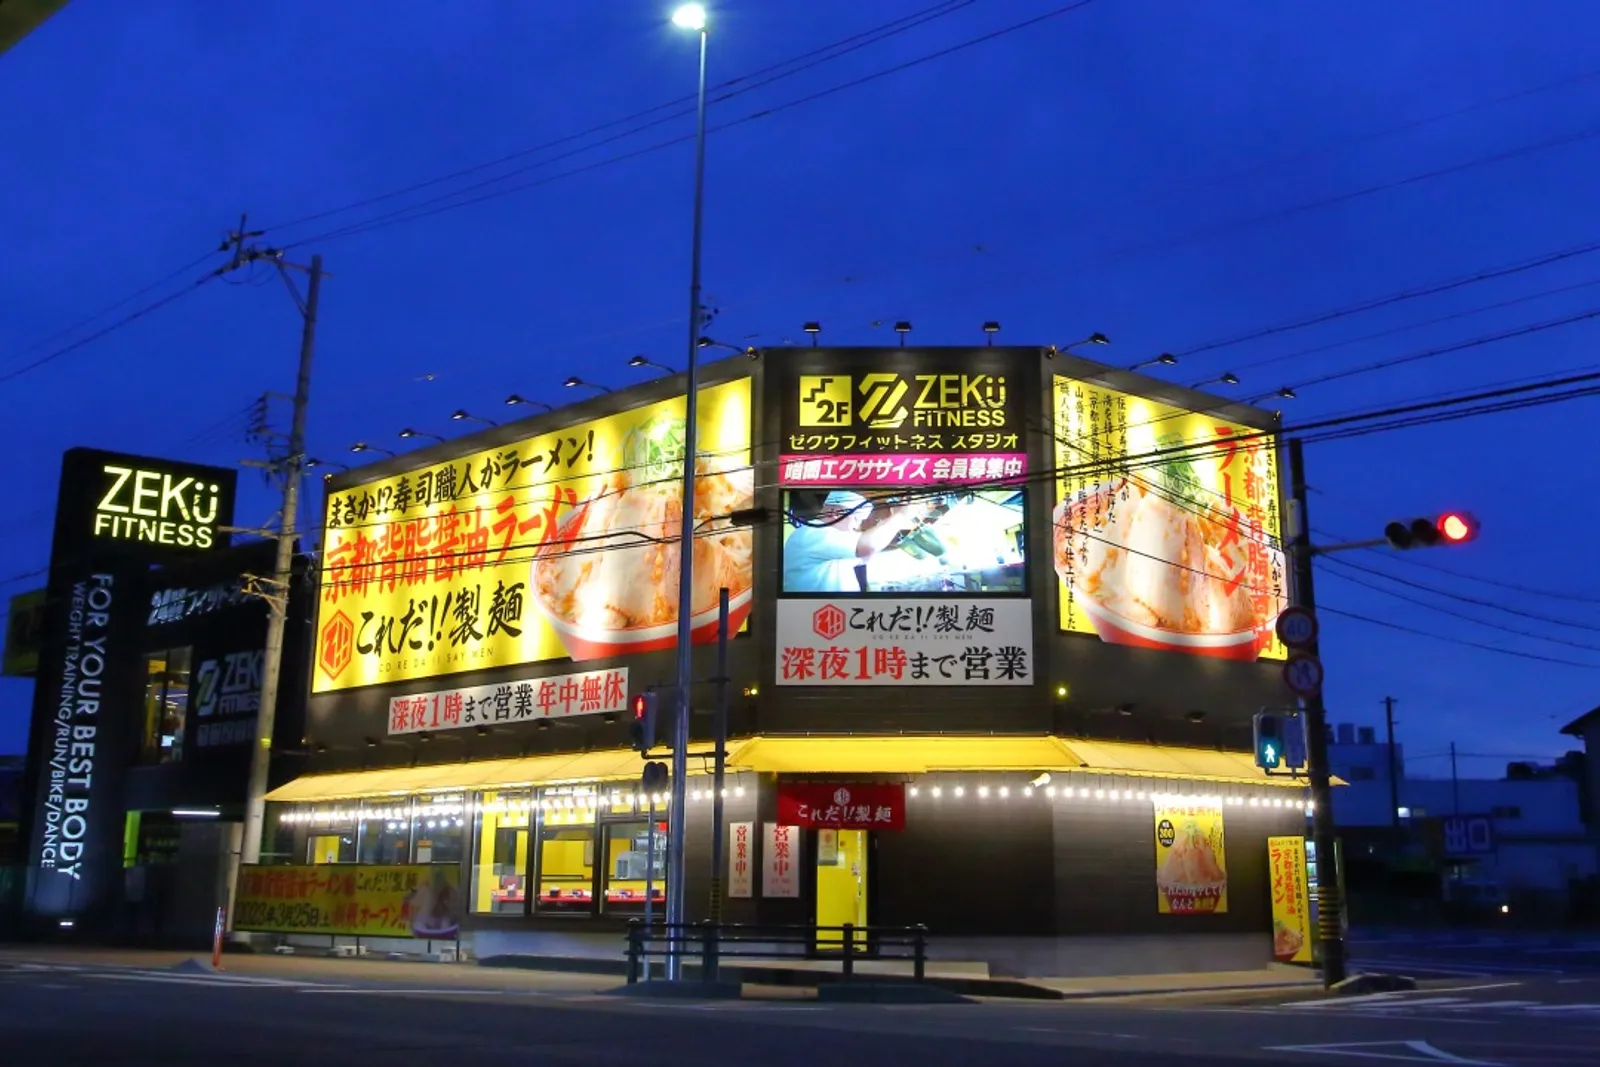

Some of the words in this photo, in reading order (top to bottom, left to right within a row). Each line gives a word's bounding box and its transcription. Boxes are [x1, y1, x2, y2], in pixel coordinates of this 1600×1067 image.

[816, 399, 849, 424] 2F
[788, 434, 944, 452] ゼクウフィットネス
[951, 432, 1020, 450] スタジオ
[932, 456, 1024, 480] 会員募集中
[94, 513, 213, 549] FITNESS
[1213, 426, 1250, 598] ラーメン
[68, 581, 87, 641] WEIGHT
[86, 573, 114, 627] FOR
[1286, 618, 1309, 637] 40
[75, 636, 107, 715] YOUR
[780, 645, 1030, 682] 深夜1時まで営業
[391, 681, 534, 730] 深夜1時まで営業
[536, 671, 626, 717] 年中無休
[67, 724, 98, 789] BEST
[57, 798, 89, 880] BODY
[735, 824, 748, 877] 営業中
[772, 825, 790, 877] 営業中
[1443, 817, 1491, 853] 出口
[1271, 848, 1286, 905] ラーメン
